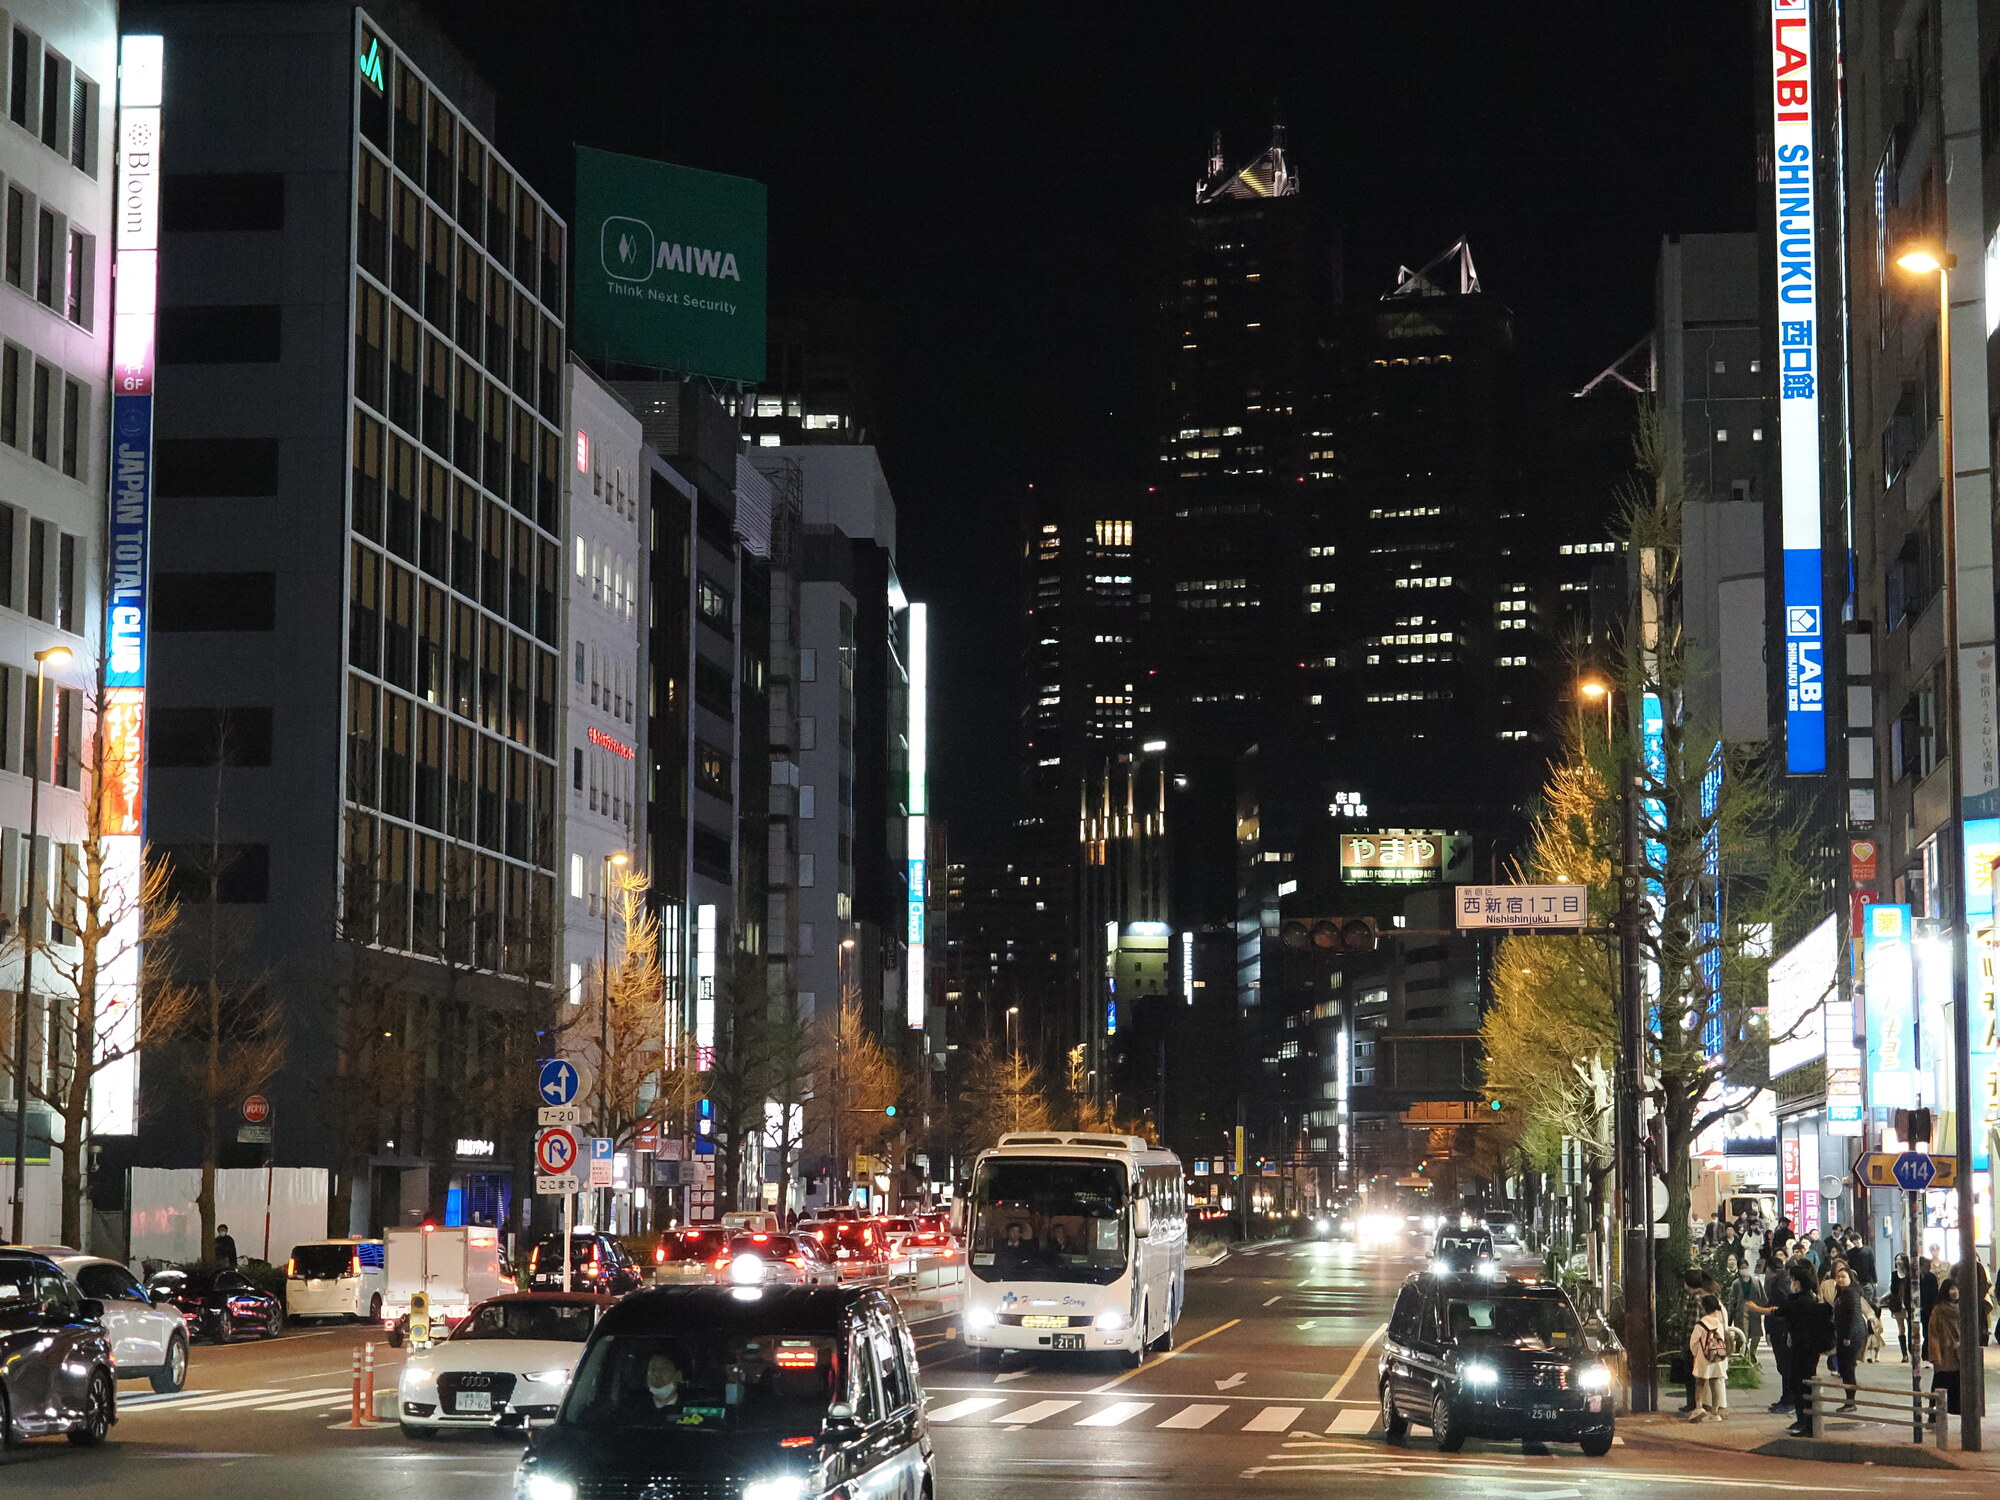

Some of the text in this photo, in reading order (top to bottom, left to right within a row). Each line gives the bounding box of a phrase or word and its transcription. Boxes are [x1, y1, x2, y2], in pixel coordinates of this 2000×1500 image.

[126, 152, 150, 233] Bloom
[1775, 18, 1815, 399] LABI SHINJUKU 西口館
[656, 241, 741, 282] MIWA
[607, 281, 737, 315] Think Next Security
[123, 377, 145, 391] 6F
[116, 443, 145, 525] JAPAN
[113, 530, 142, 604] TOTAL
[111, 606, 142, 674] CLUB
[1787, 642, 1798, 686] SHINJUKU
[1798, 641, 1822, 711] LABI
[121, 703, 142, 833] パソコンスクール
[1349, 838, 1436, 865] やまや
[1350, 869, 1374, 879] WORLD
[1463, 896, 1579, 914] 西新宿1丁目
[1485, 914, 1559, 925] Nishishinjuku 1
[1876, 912, 1899, 932] 薬
[543, 1111, 574, 1122] 7-20
[596, 1140, 609, 1158] P
[539, 1180, 576, 1190] ここまで
